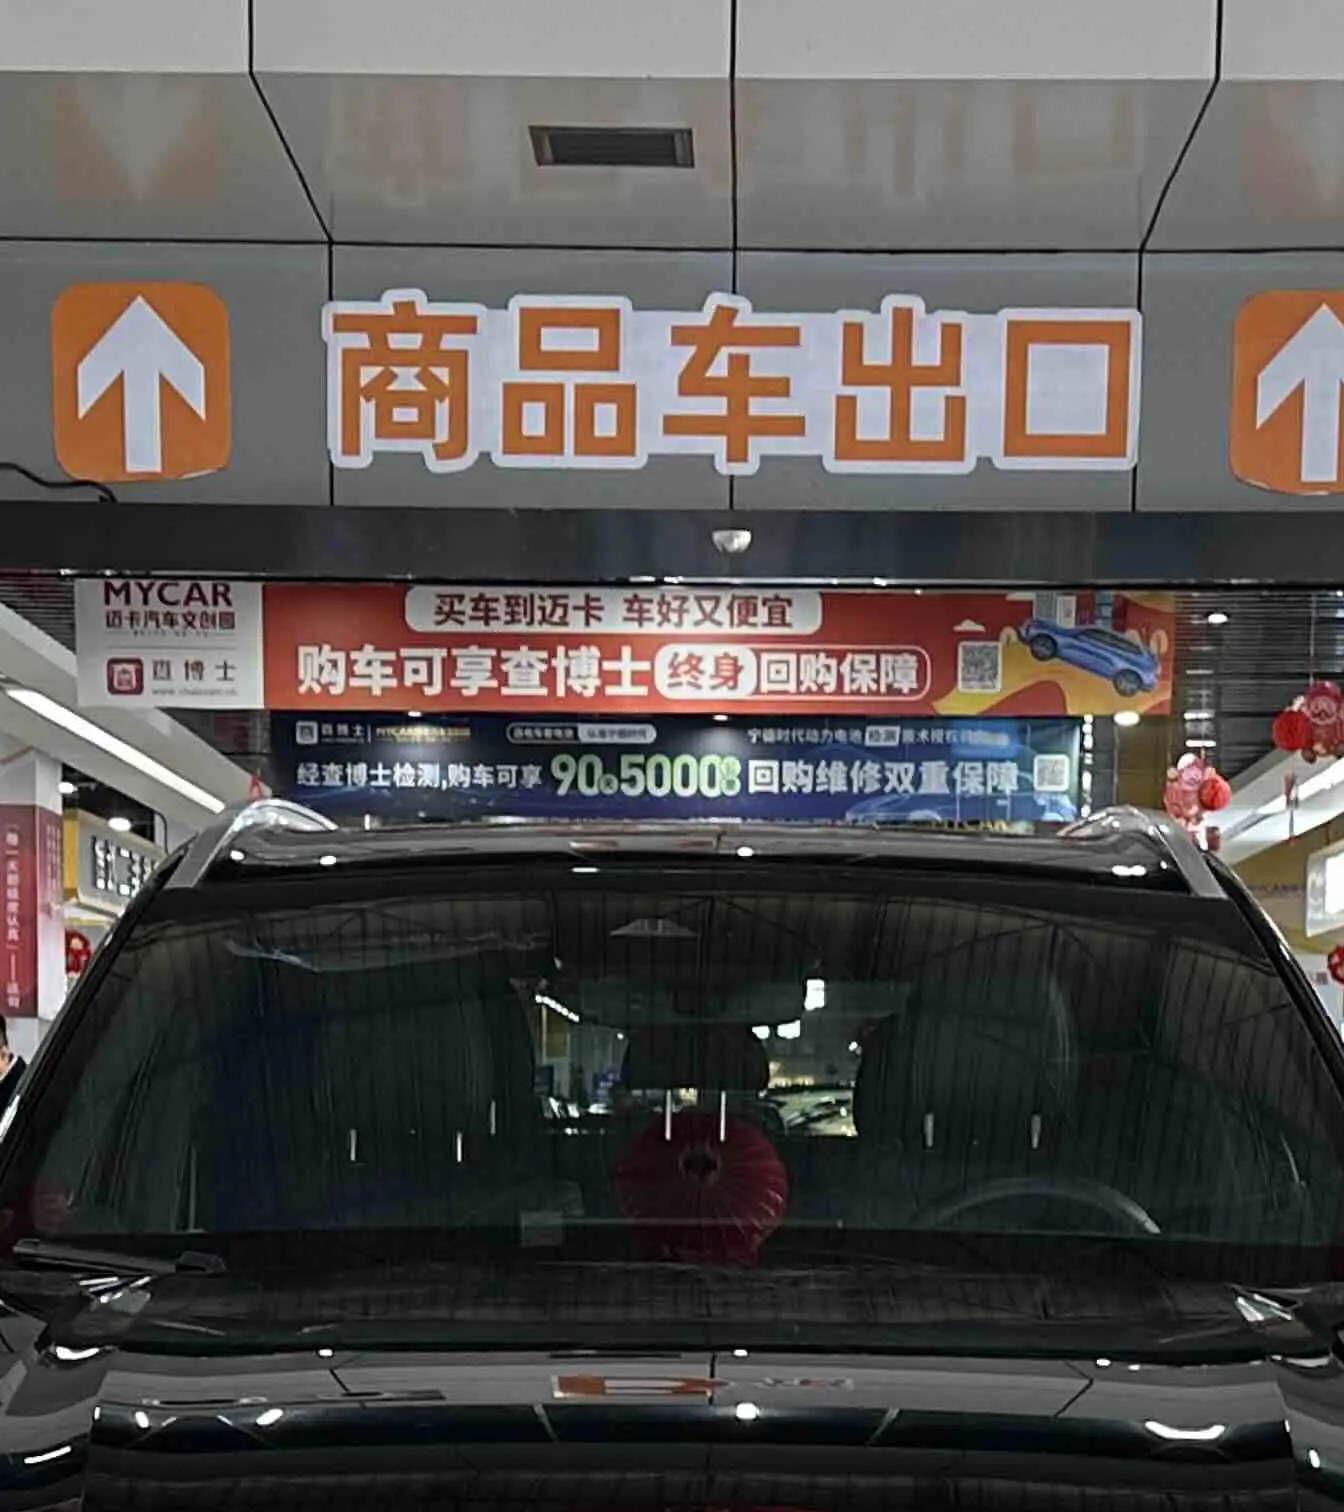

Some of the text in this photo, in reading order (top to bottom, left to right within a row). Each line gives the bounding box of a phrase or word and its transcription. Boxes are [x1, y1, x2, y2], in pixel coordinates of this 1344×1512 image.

[326, 294, 1138, 470] 商品车出口
[103, 580, 234, 607] MYCAR
[434, 592, 793, 629] 买车到迈卡 车好又便宜
